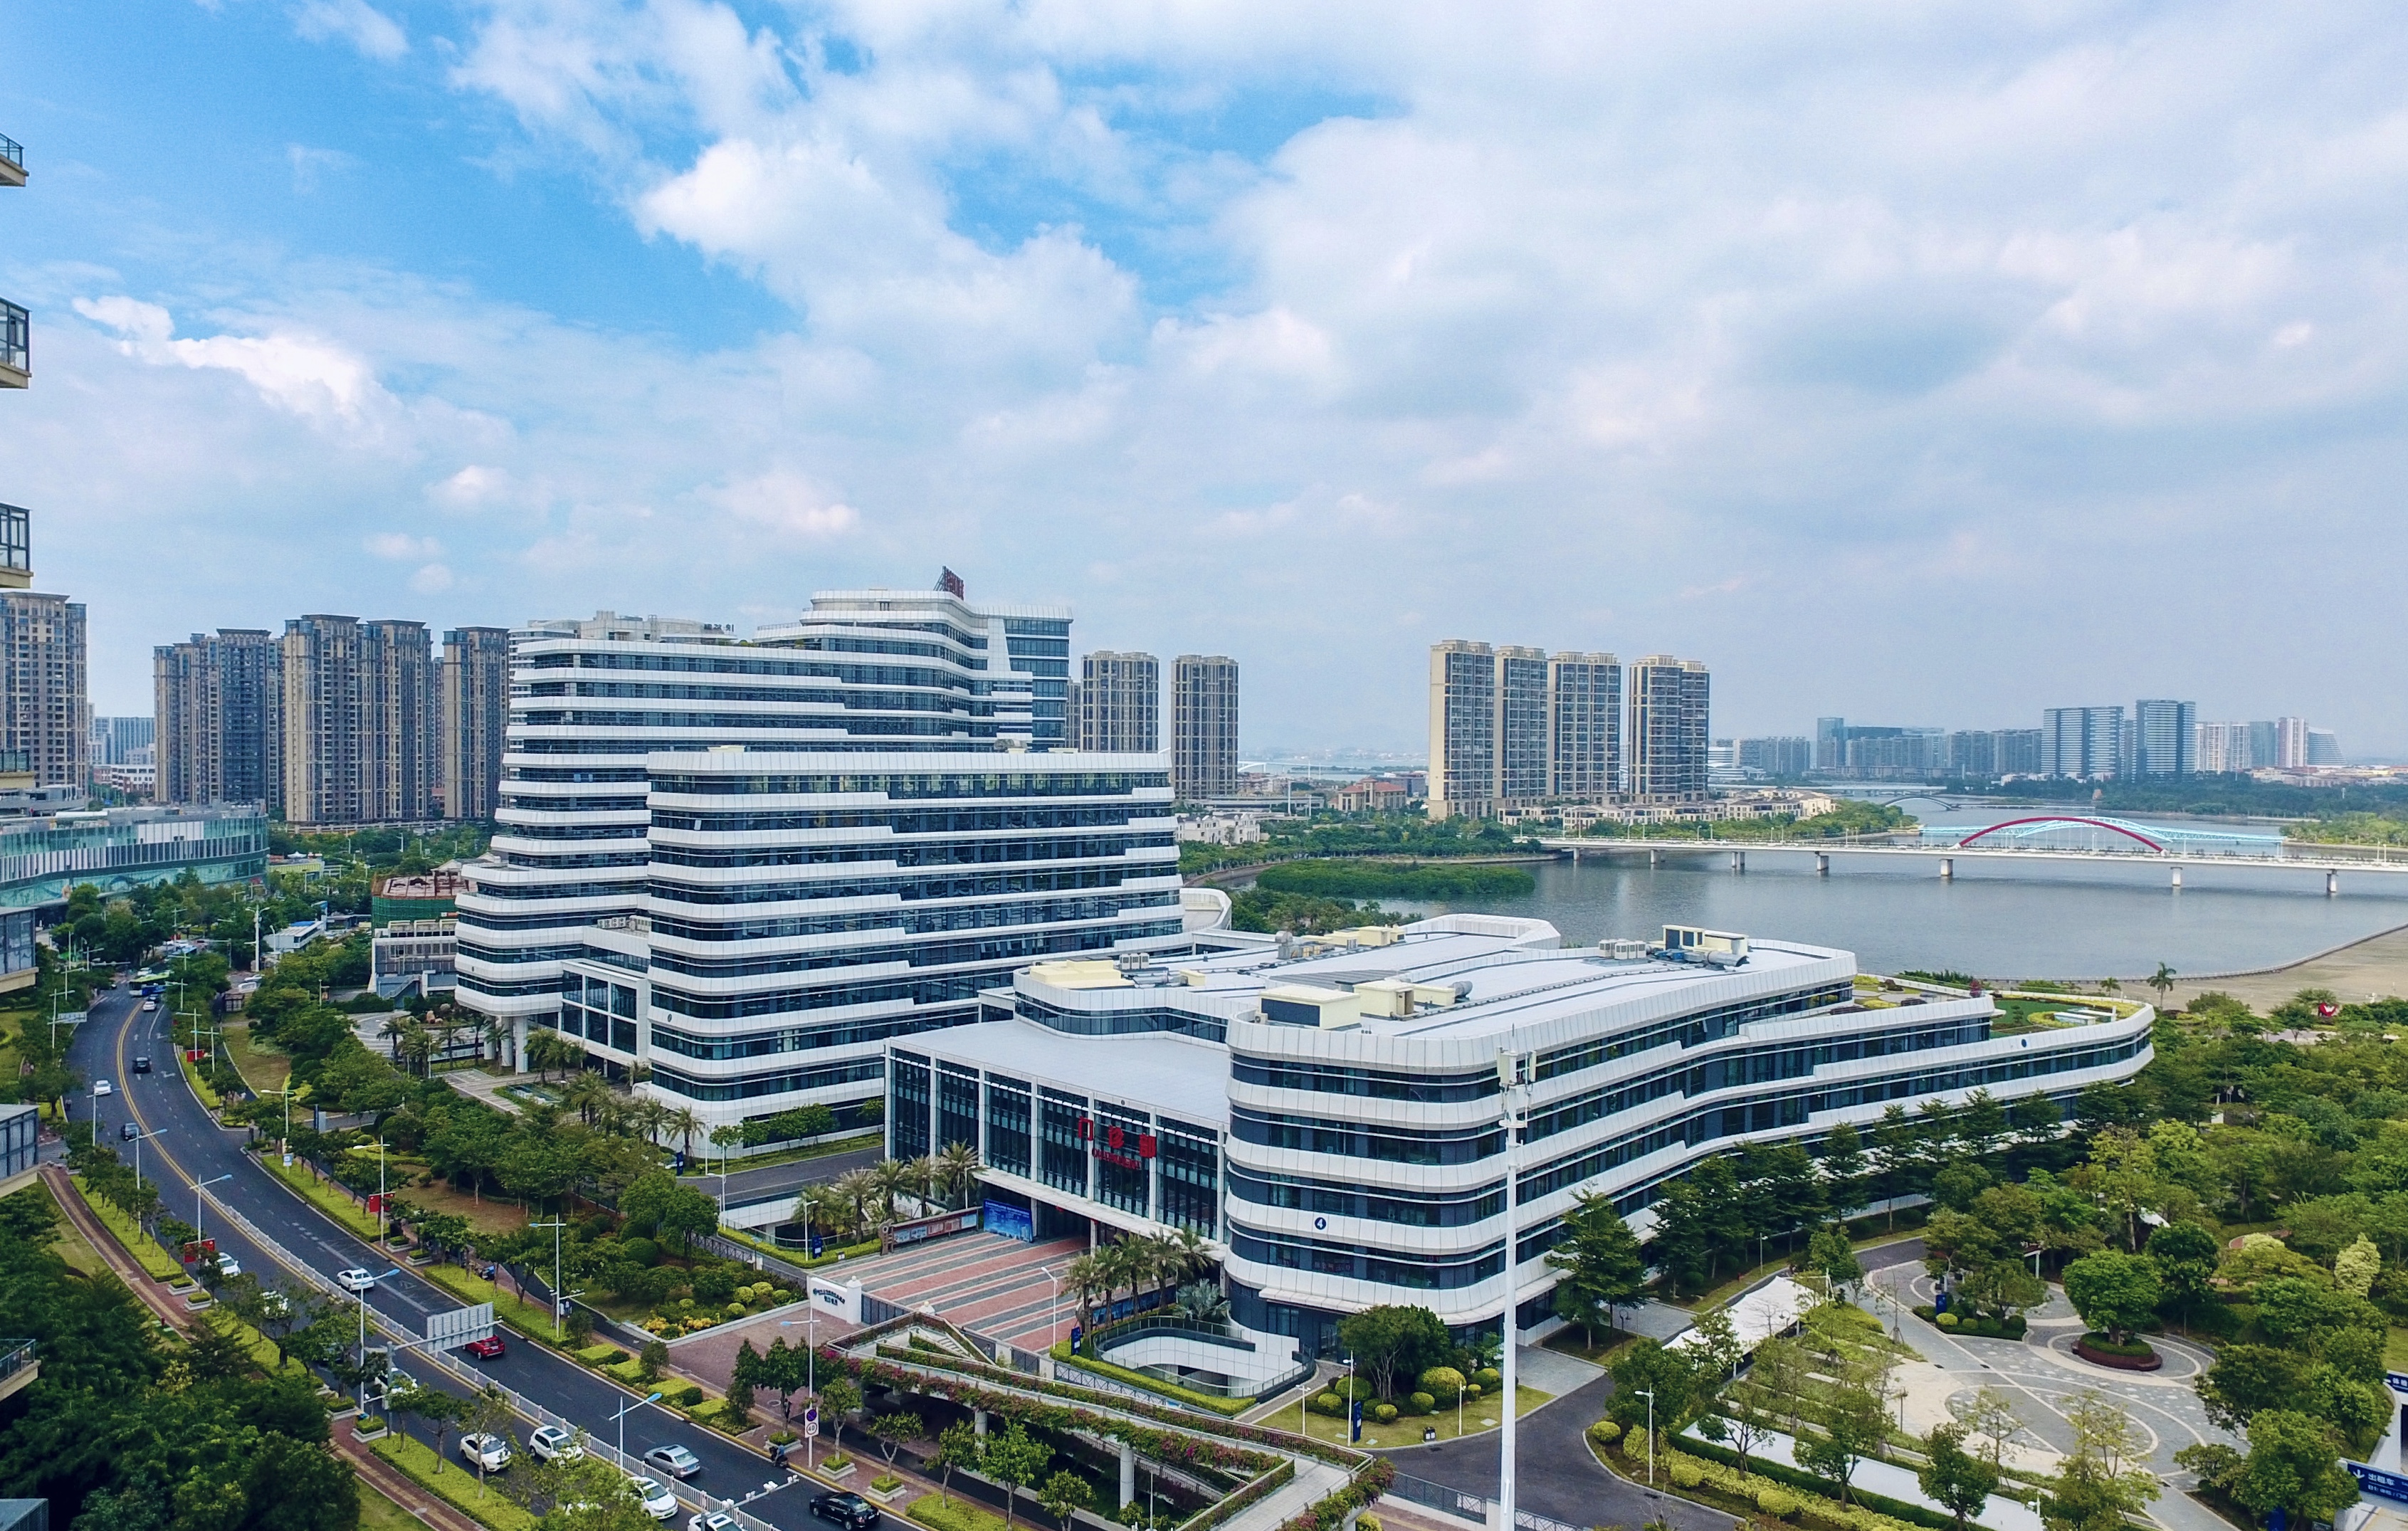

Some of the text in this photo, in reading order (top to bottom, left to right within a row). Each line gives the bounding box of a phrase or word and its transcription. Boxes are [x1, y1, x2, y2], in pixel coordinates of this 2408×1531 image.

[1078, 1115, 1157, 1159] 门诊部
[1317, 1218, 1323, 1229] 4
